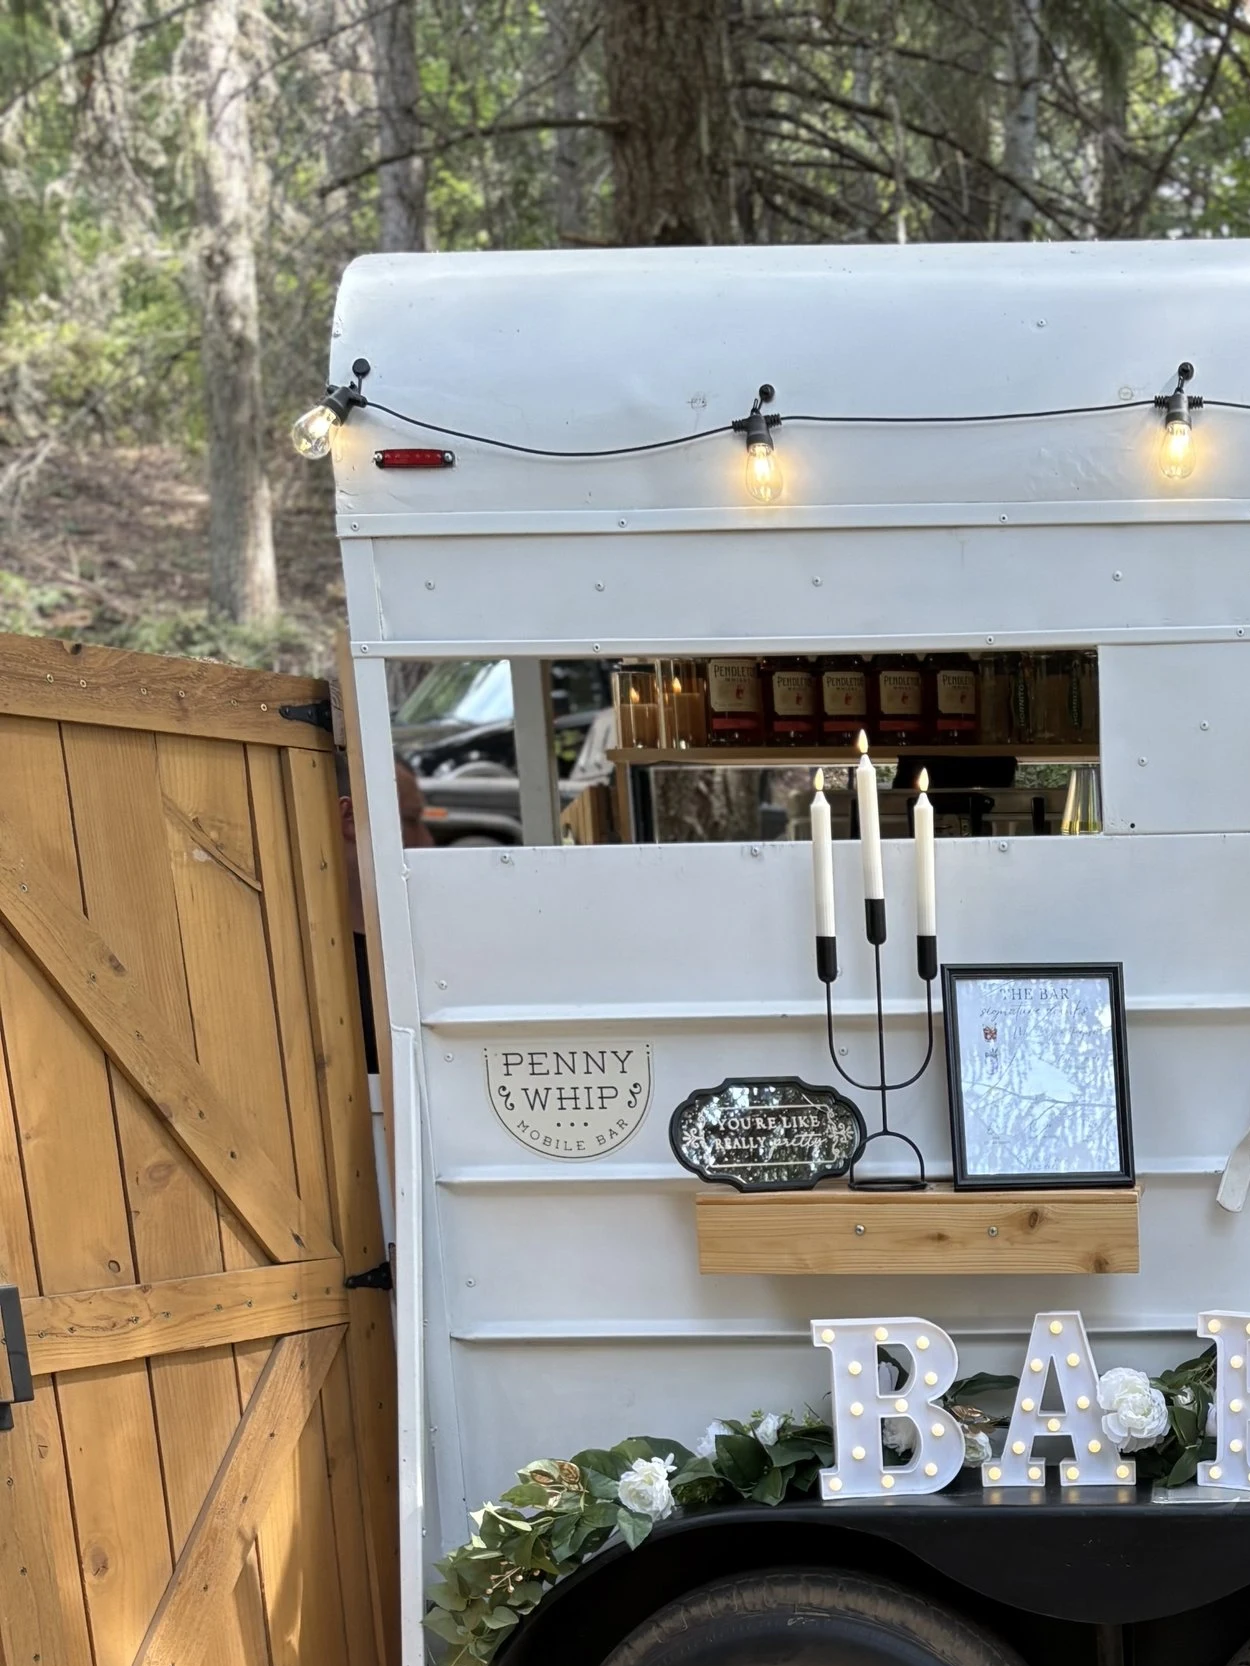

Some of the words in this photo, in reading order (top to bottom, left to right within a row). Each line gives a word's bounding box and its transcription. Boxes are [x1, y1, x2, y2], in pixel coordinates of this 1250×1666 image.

[1000, 987, 1033, 1001] THE
[1039, 987, 1070, 1000] BAR
[502, 1050, 634, 1077] PENNY
[521, 1085, 619, 1112] WHIP
[516, 1119, 586, 1152] MOBILE
[597, 1118, 629, 1145] BAR
[716, 1116, 777, 1131] YOU'RE
[781, 1115, 821, 1129] LIKE
[714, 1135, 767, 1151] REALLY
[765, 1132, 828, 1162] pretty
